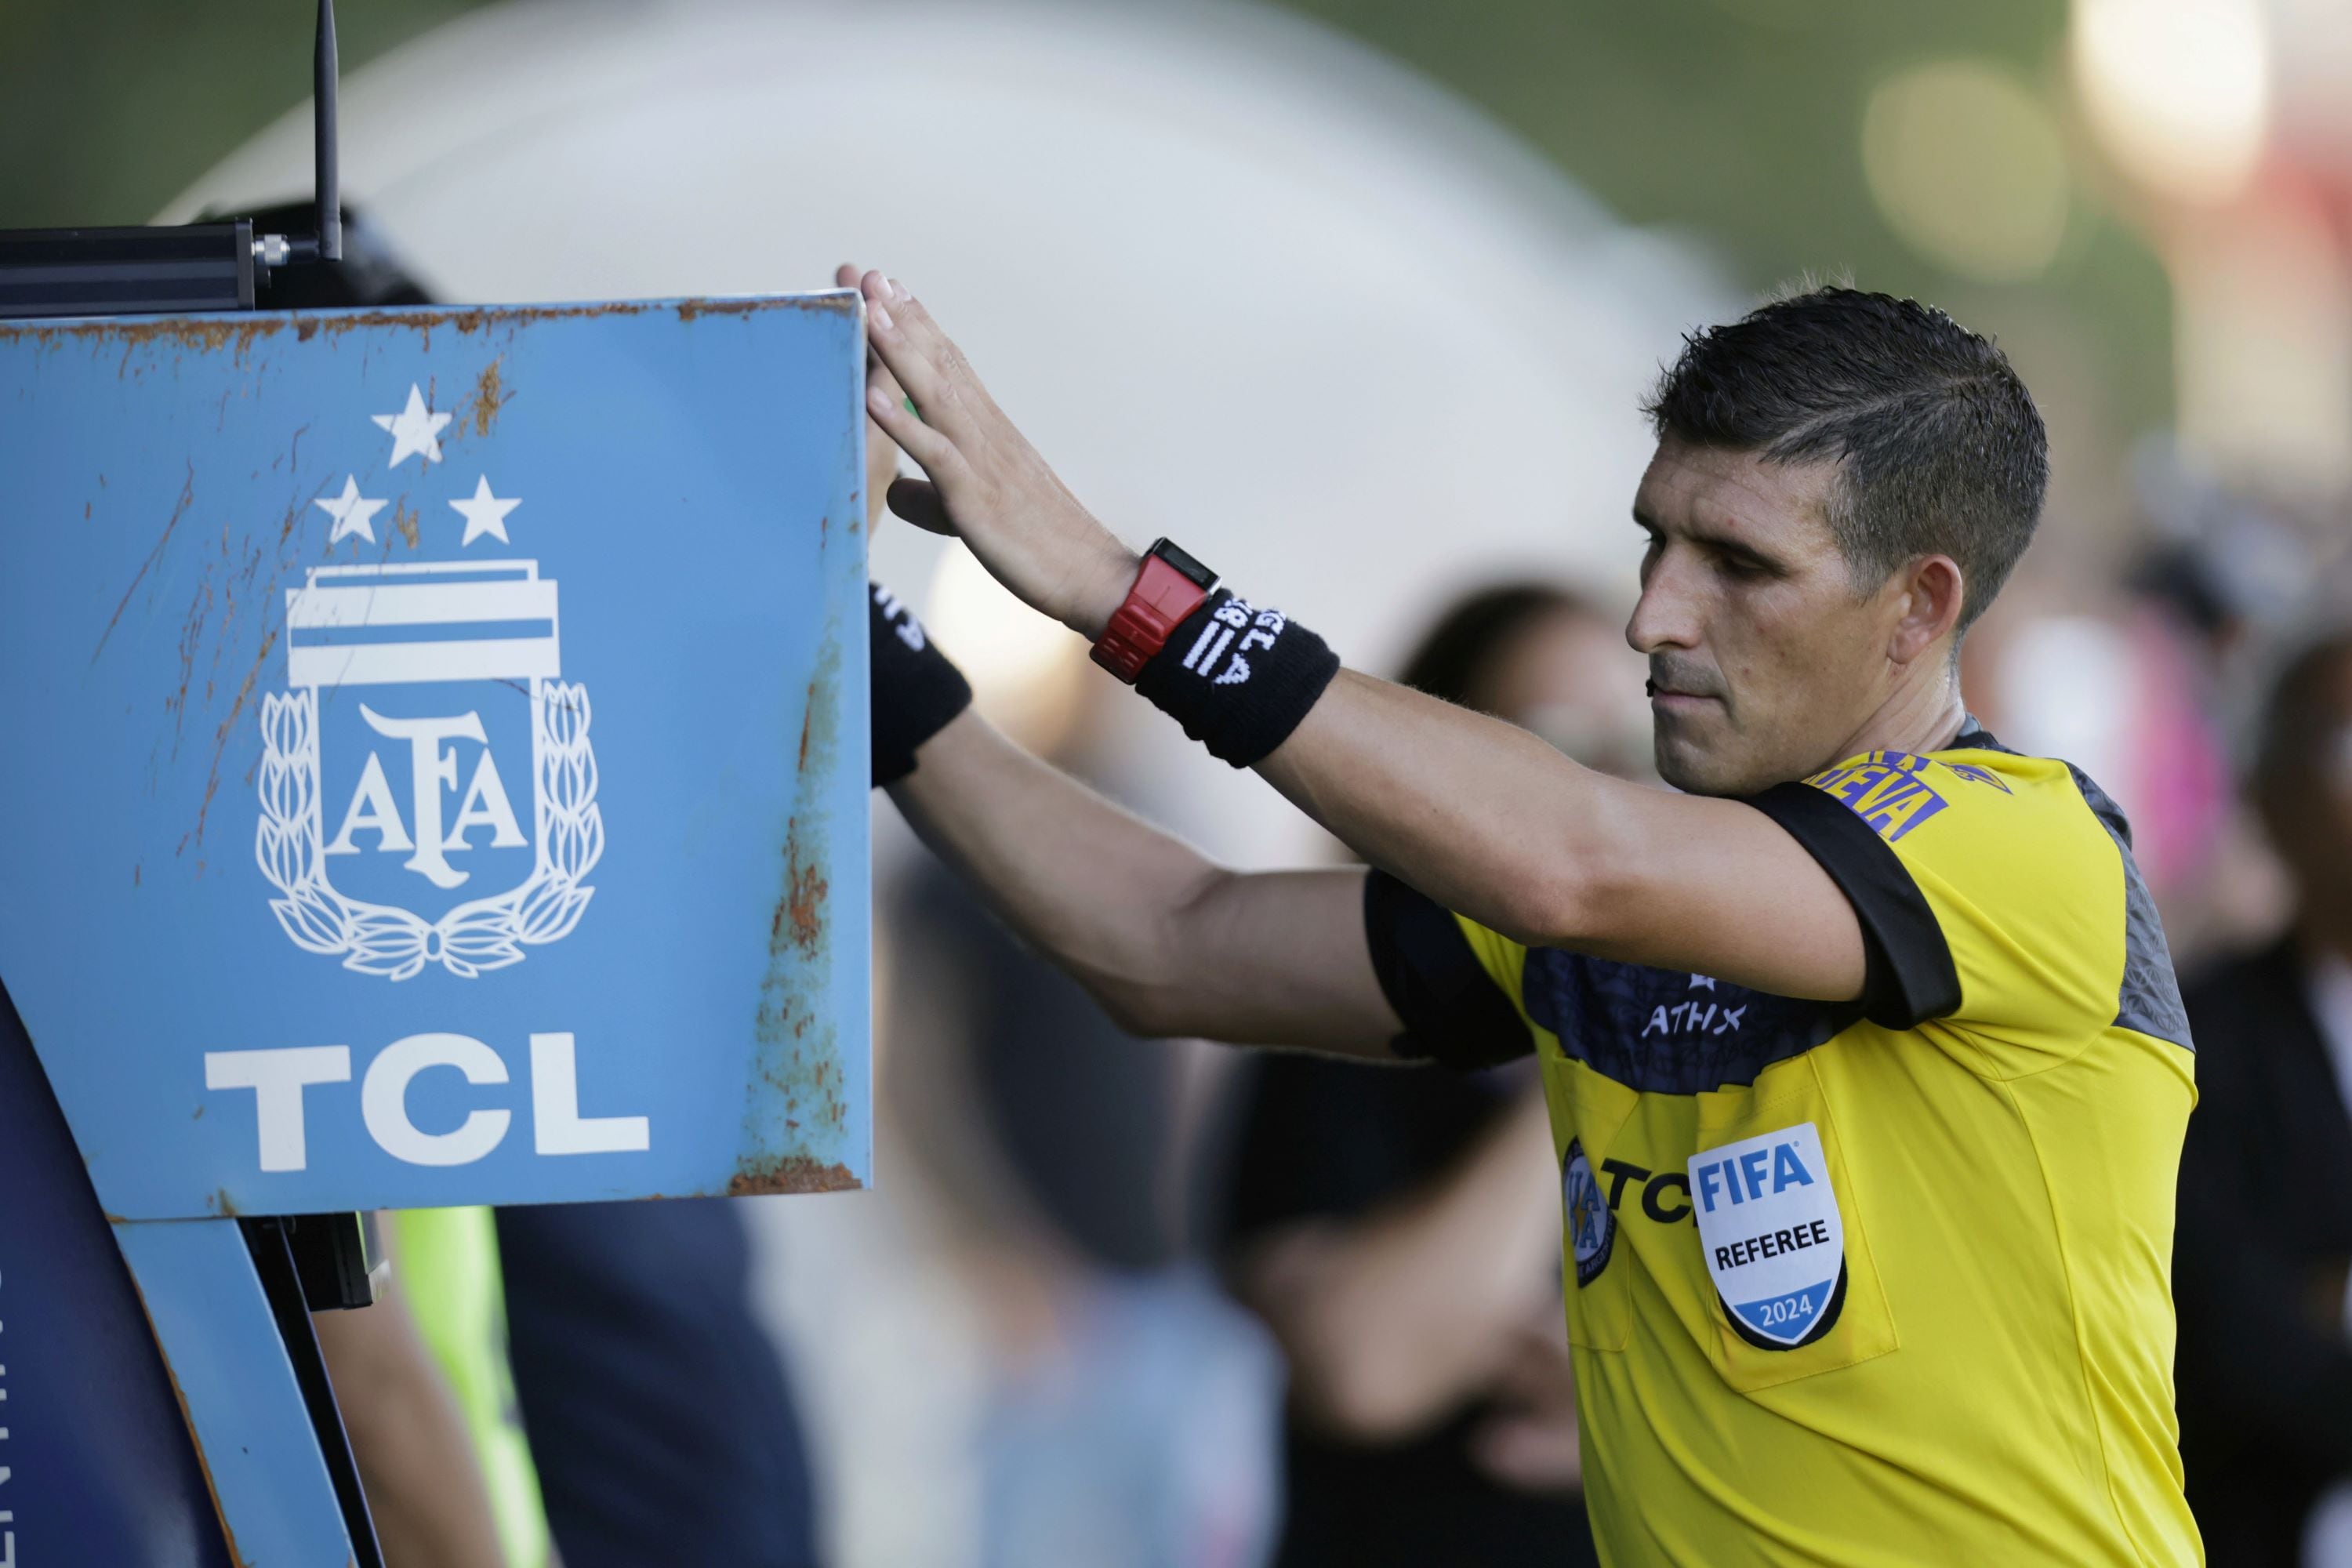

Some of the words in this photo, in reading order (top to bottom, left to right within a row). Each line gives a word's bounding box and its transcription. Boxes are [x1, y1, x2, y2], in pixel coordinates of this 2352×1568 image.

[323, 702, 528, 889] AFA
[1802, 765, 1934, 839] UEVA
[205, 1033, 650, 1172] TCL
[1600, 1156, 1698, 1229] TC
[1697, 1143, 1814, 1213] FIFA
[1715, 1219, 1830, 1271] REFEREE
[1760, 1294, 1813, 1327] 2024
